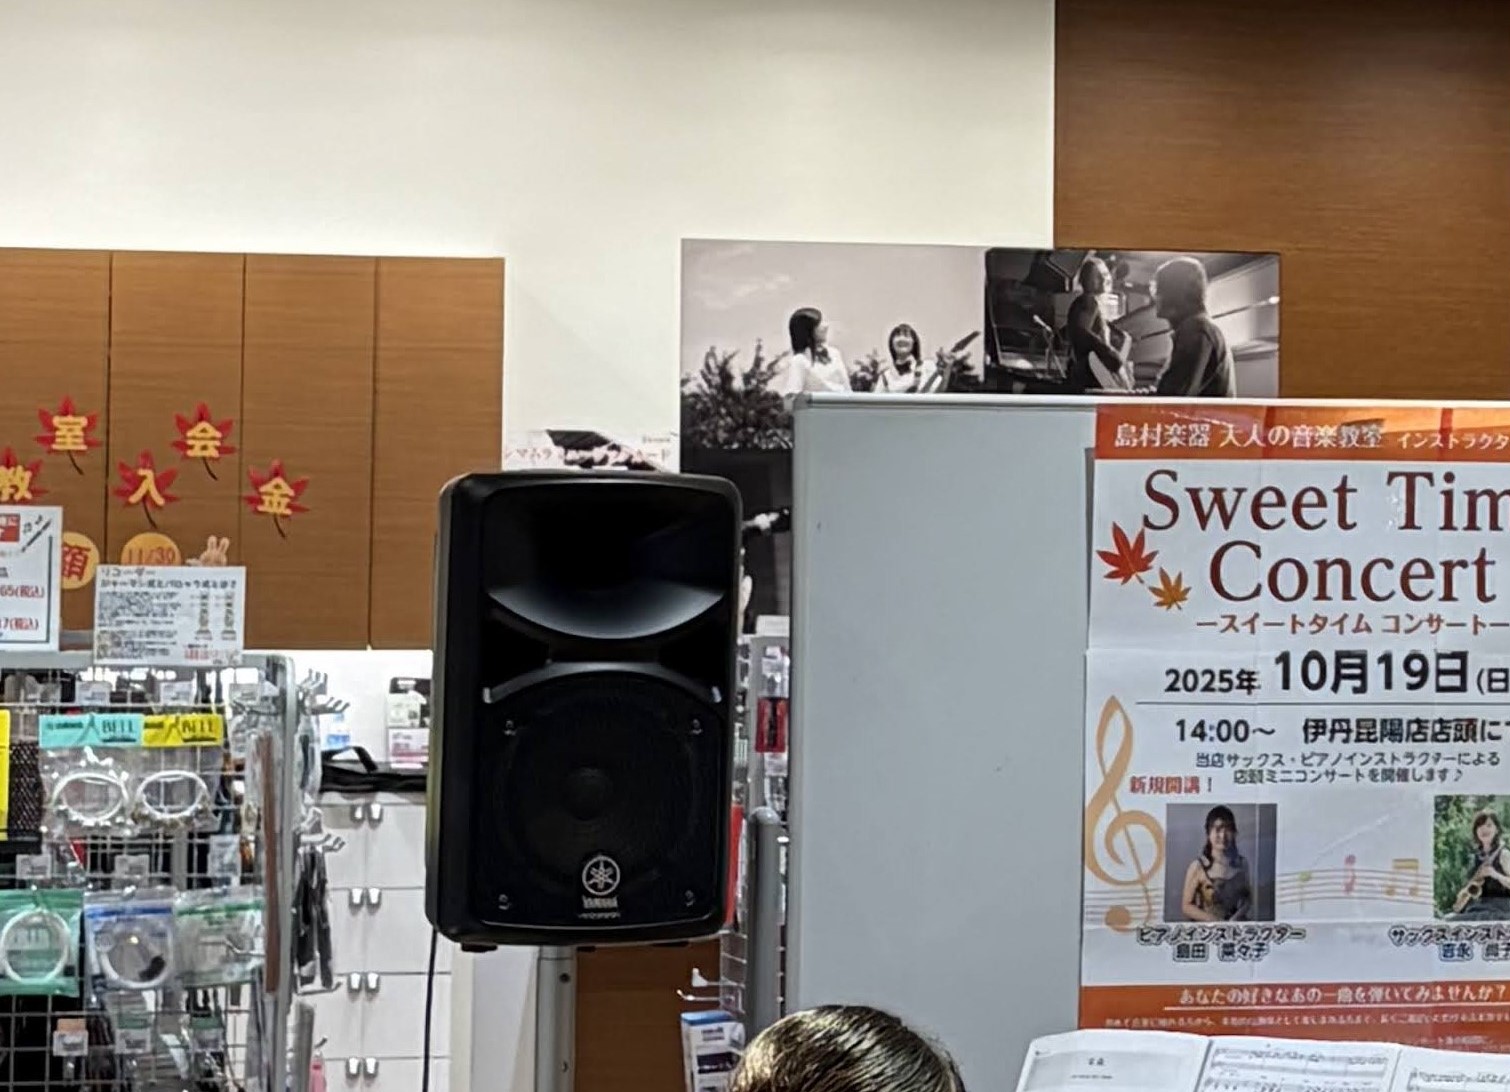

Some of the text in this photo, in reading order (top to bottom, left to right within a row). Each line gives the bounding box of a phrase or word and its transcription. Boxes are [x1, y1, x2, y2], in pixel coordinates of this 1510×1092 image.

[1115, 424, 1211, 449] 島村楽器
[1218, 424, 1384, 449] 大人の音楽教室
[1142, 469, 1358, 531] Sweet
[1209, 540, 1497, 603] Concert
[1165, 667, 1262, 695] 2025年
[1274, 650, 1470, 695] 10月19日
[1196, 751, 1501, 768] 当店サックス・ピアノインストラクターによる
